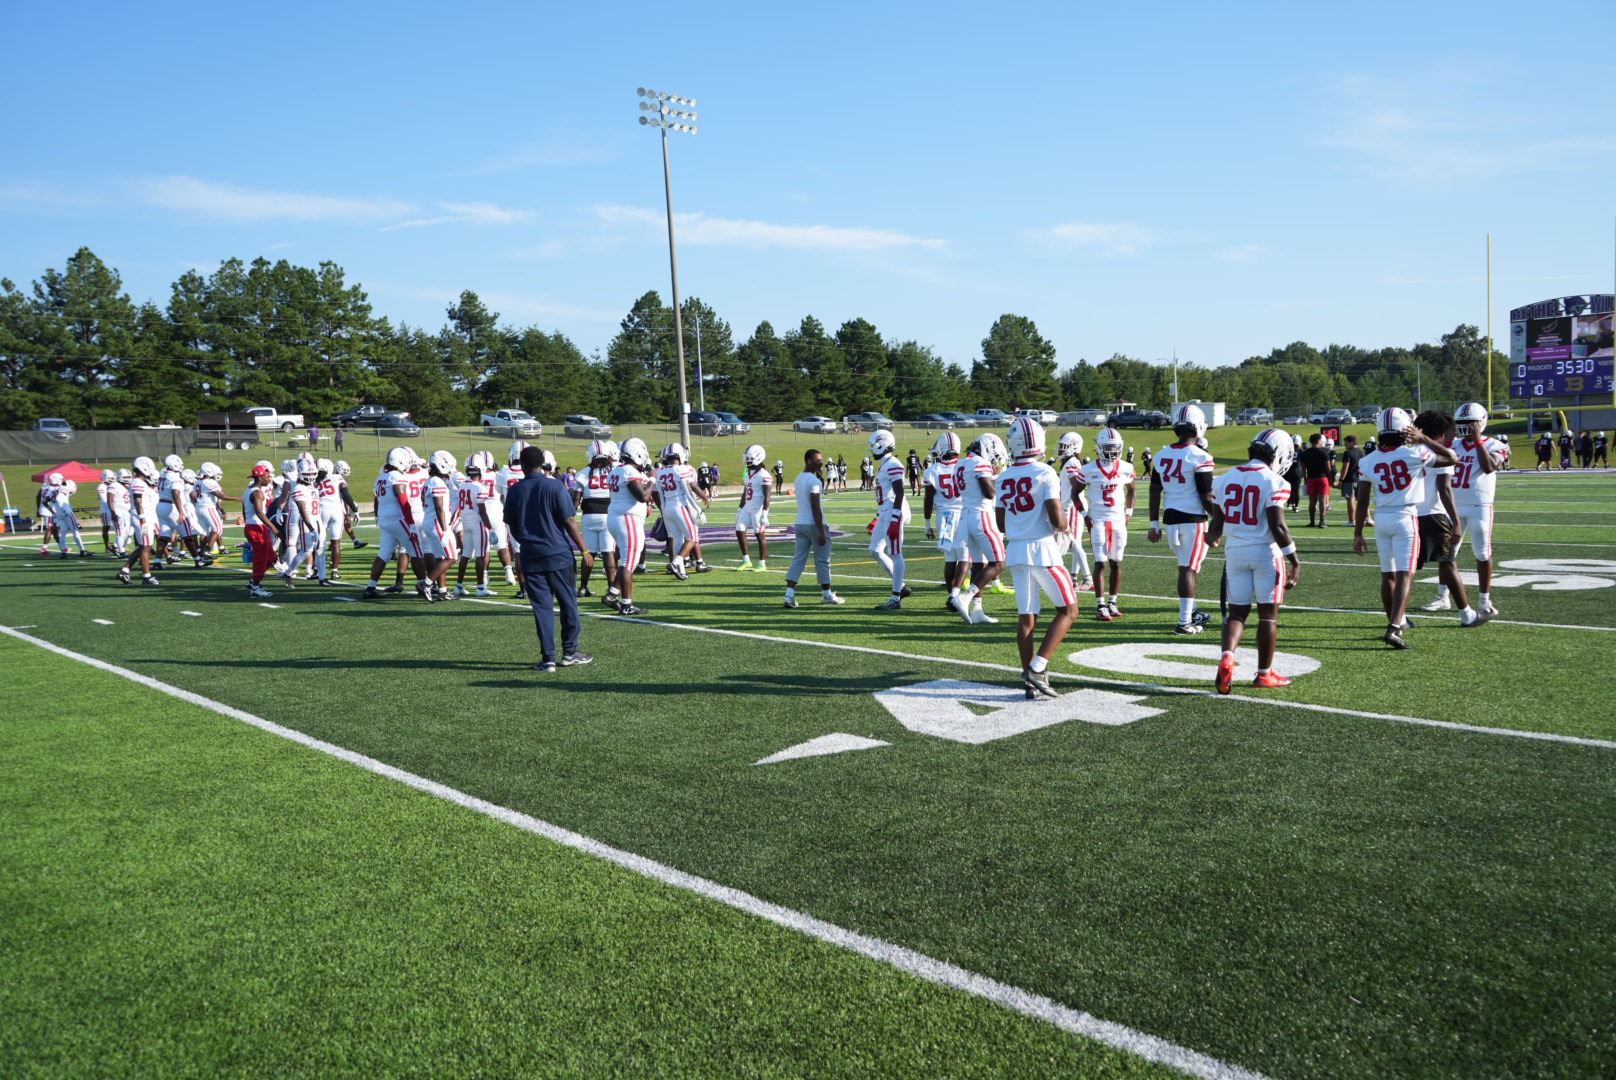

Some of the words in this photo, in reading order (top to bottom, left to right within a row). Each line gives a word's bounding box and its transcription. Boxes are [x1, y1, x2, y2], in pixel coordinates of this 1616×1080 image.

[1511, 299, 1563, 321] BETHEL
[1518, 365, 1526, 377] 0
[1323, 428, 1338, 441] 40
[660, 473, 677, 491] 33
[1160, 458, 1186, 484] 74
[1374, 460, 1412, 494] 38
[1451, 463, 1473, 489] 91
[1000, 477, 1035, 515] 28
[1102, 489, 1116, 507] 5
[1224, 484, 1260, 525] 20
